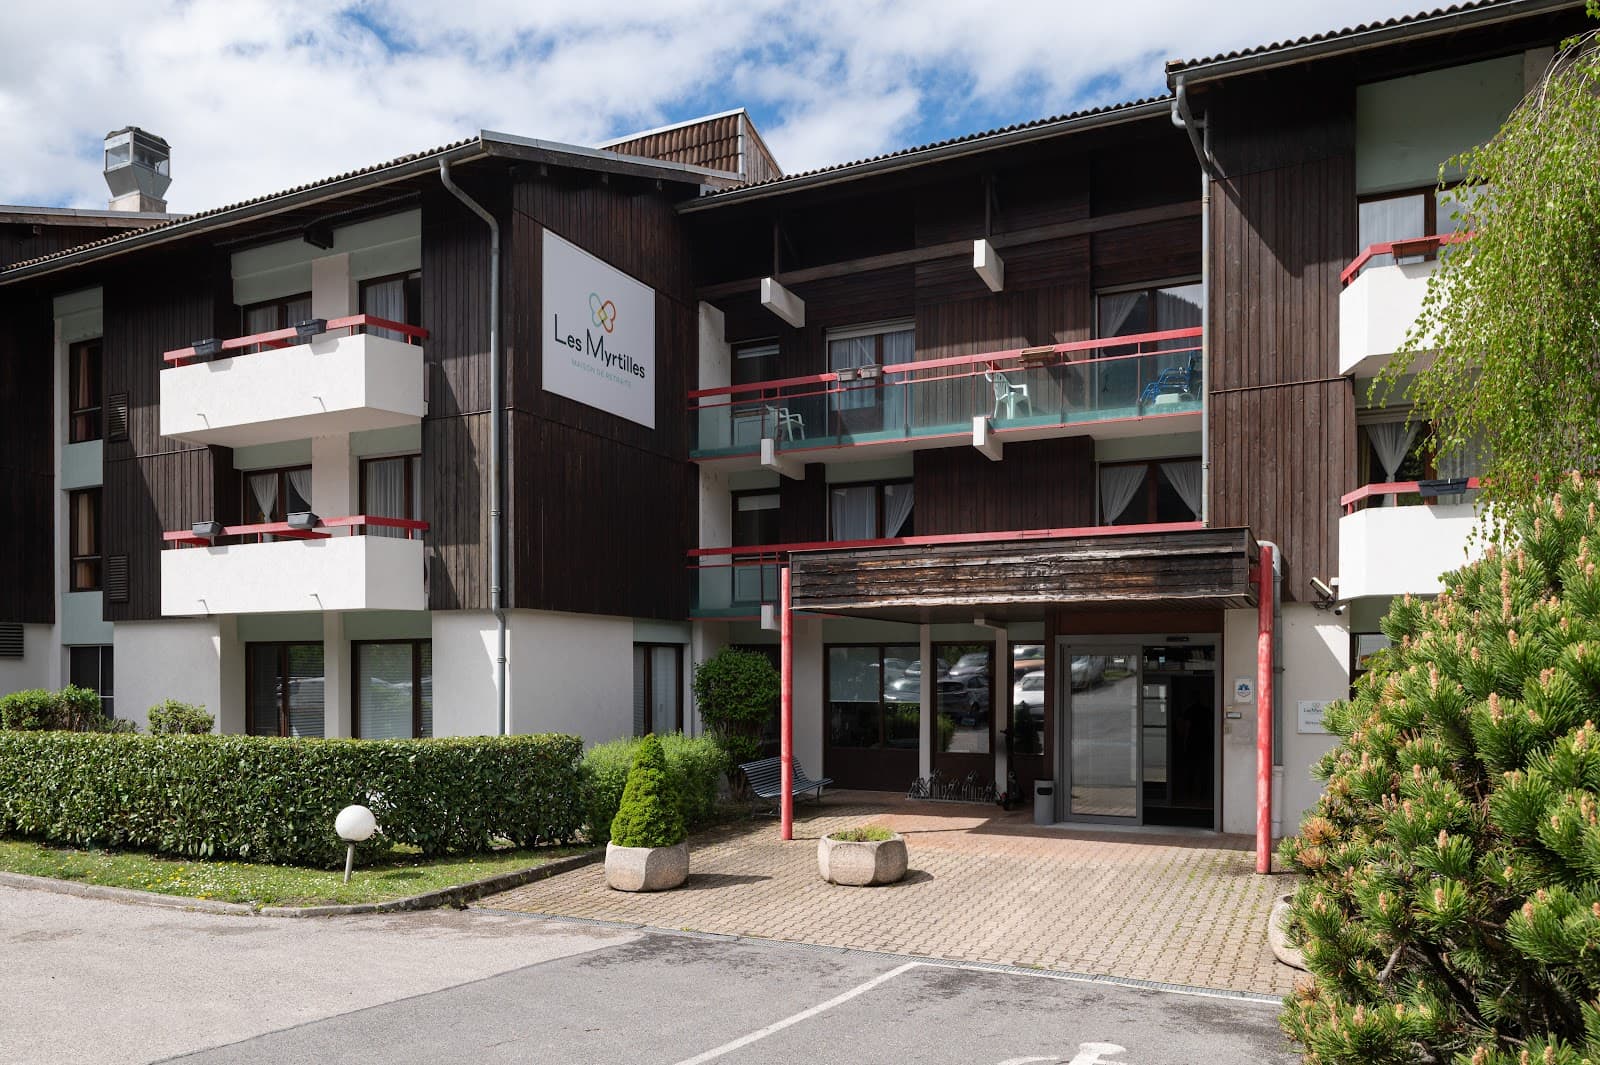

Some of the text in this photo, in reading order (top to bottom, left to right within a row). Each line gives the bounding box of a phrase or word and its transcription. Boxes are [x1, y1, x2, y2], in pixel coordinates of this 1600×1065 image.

[554, 313, 645, 379] Les Myrtilles
[571, 358, 595, 375] MAISON
[596, 368, 605, 379] DE
